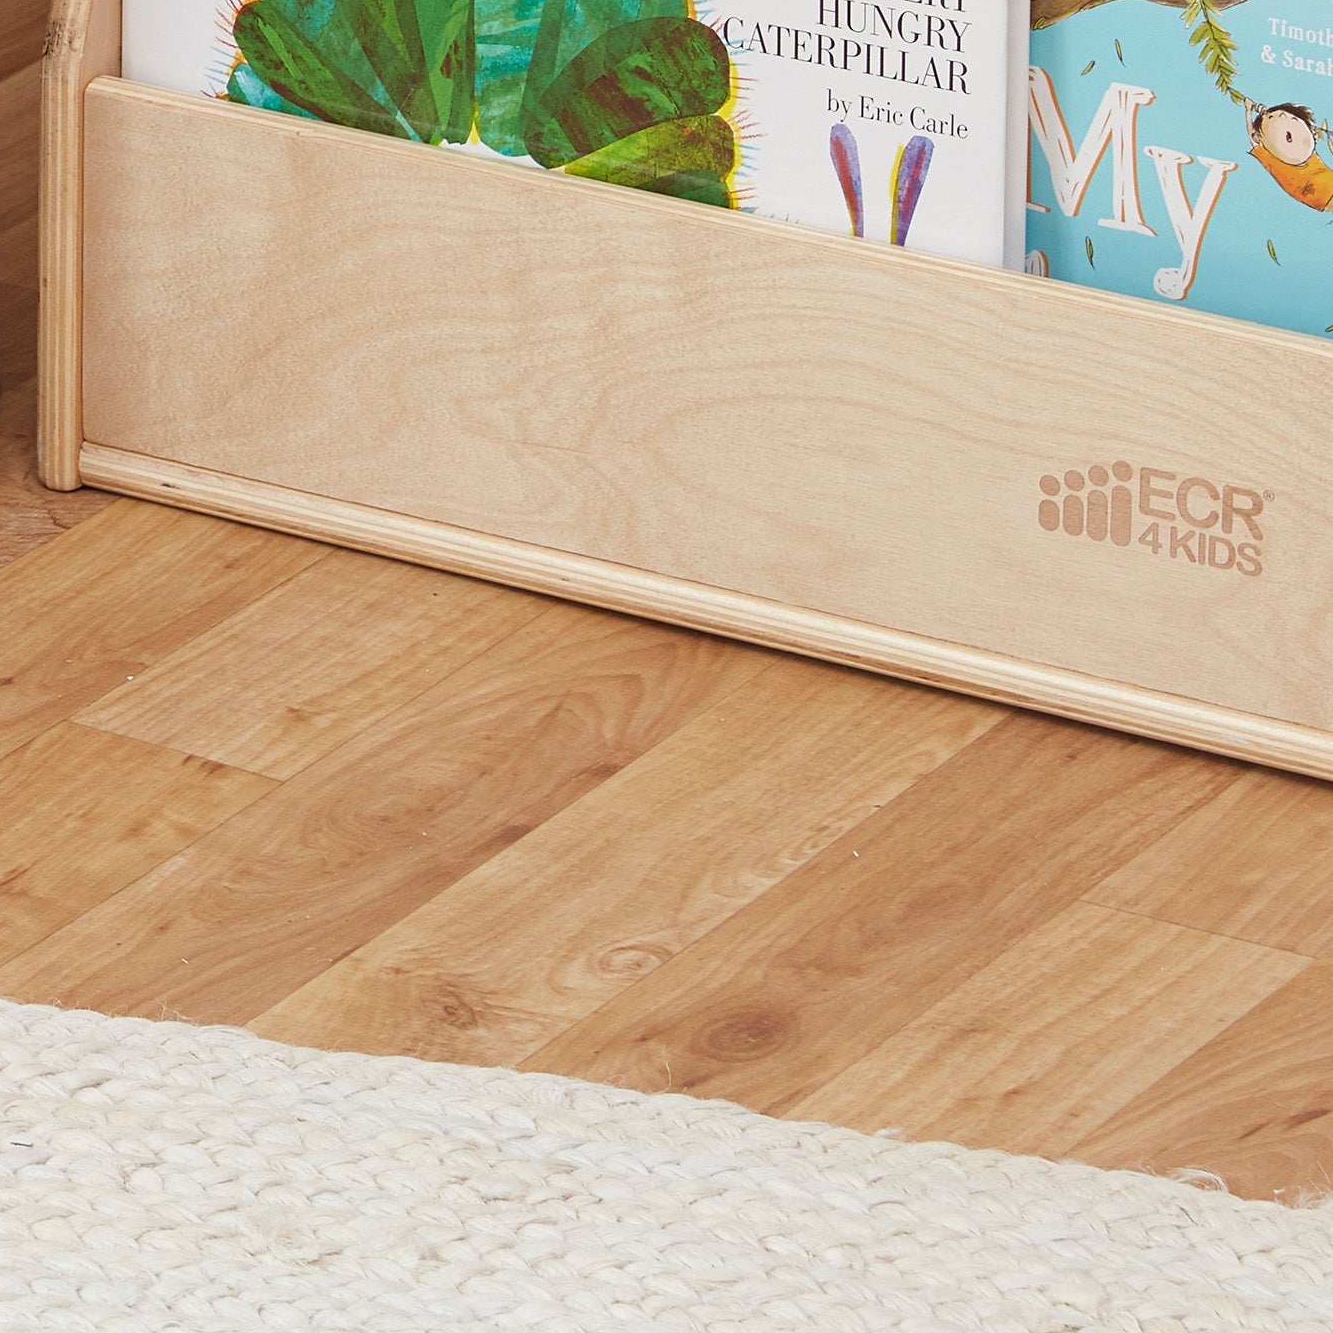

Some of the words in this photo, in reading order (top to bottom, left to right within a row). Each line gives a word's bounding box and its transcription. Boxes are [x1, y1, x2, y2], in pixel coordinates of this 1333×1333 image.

[723, 16, 971, 95] CATERPILLAR
[826, 88, 852, 122] by
[858, 94, 903, 126] Eric
[909, 106, 969, 139] Carle
